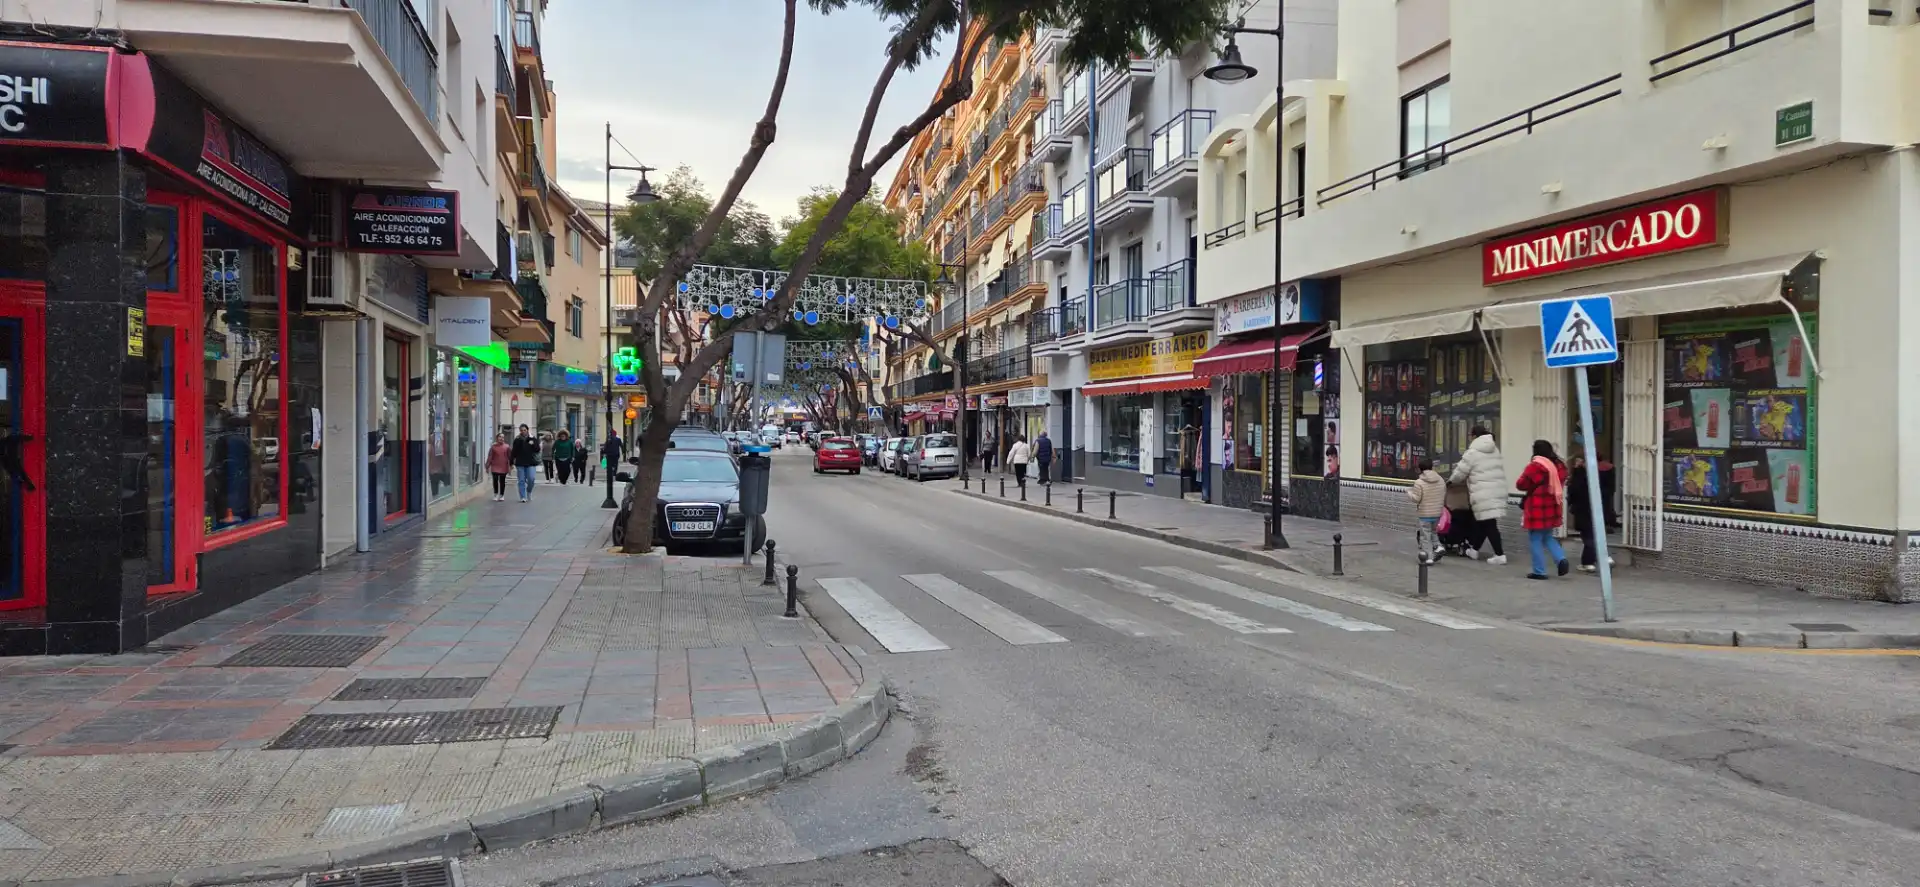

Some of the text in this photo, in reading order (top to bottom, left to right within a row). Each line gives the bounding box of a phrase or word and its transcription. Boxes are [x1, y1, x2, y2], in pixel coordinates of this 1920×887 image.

[196, 161, 213, 181] AIRE
[354, 212, 446, 225] AIRE ACONDICIONADO
[371, 223, 430, 234] CALEFACCION
[384, 234, 401, 244] 952
[403, 235, 415, 245] 46
[416, 236, 428, 245] 64
[430, 236, 442, 246] 75
[1492, 203, 1701, 277] MINIMERCADO
[1121, 334, 1206, 360] MEDITERRANEO
